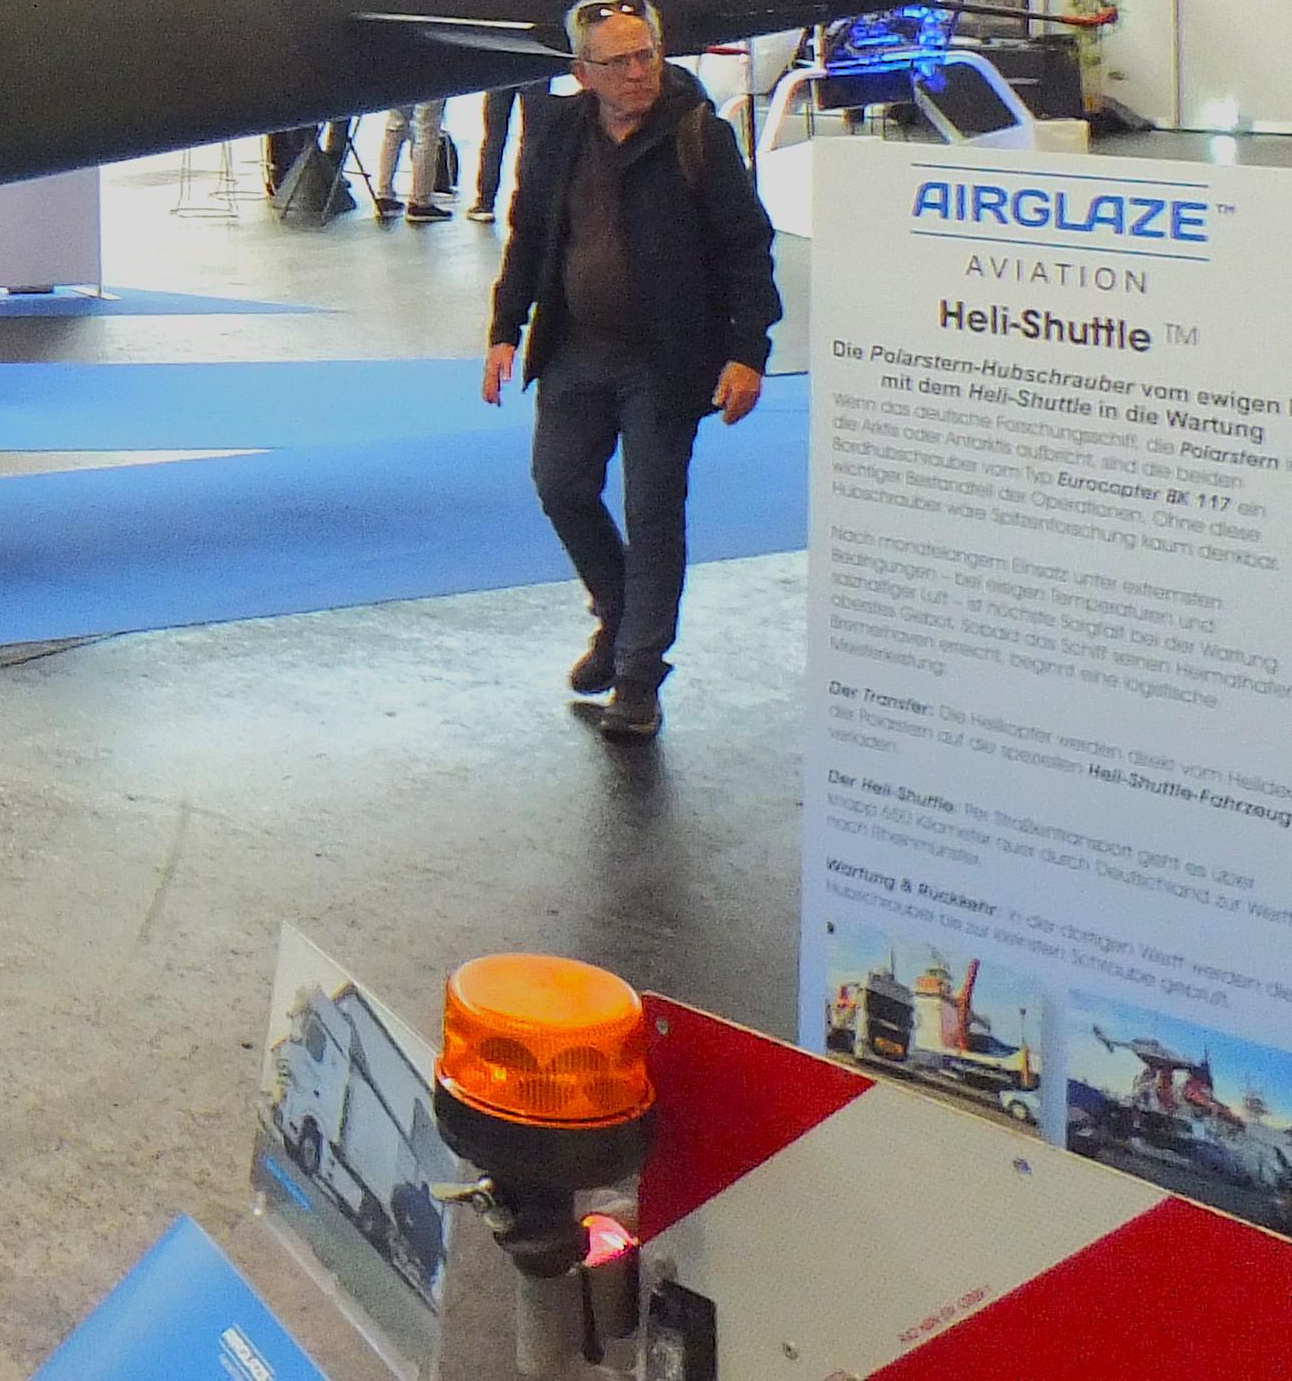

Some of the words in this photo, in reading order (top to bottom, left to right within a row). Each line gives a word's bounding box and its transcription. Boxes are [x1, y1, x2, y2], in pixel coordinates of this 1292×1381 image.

[911, 180, 1209, 243] AIRGLAZE
[966, 254, 1148, 295] AVIATION
[938, 298, 1152, 352] Heli-Shuttle
[833, 339, 863, 360] Die
[869, 343, 1135, 394] Polarstern-Hubschrauber
[1140, 376, 1189, 401] vom
[1196, 383, 1280, 414] ewigen
[880, 371, 912, 392] mit
[918, 376, 961, 398] dem
[968, 383, 1092, 416] Heli-Shuttle
[1125, 403, 1159, 425] die
[1166, 408, 1264, 439] Wartung
[1179, 439, 1280, 469] Polarstern
[1057, 470, 1161, 501] Eurocopter
[1196, 491, 1231, 511] 117
